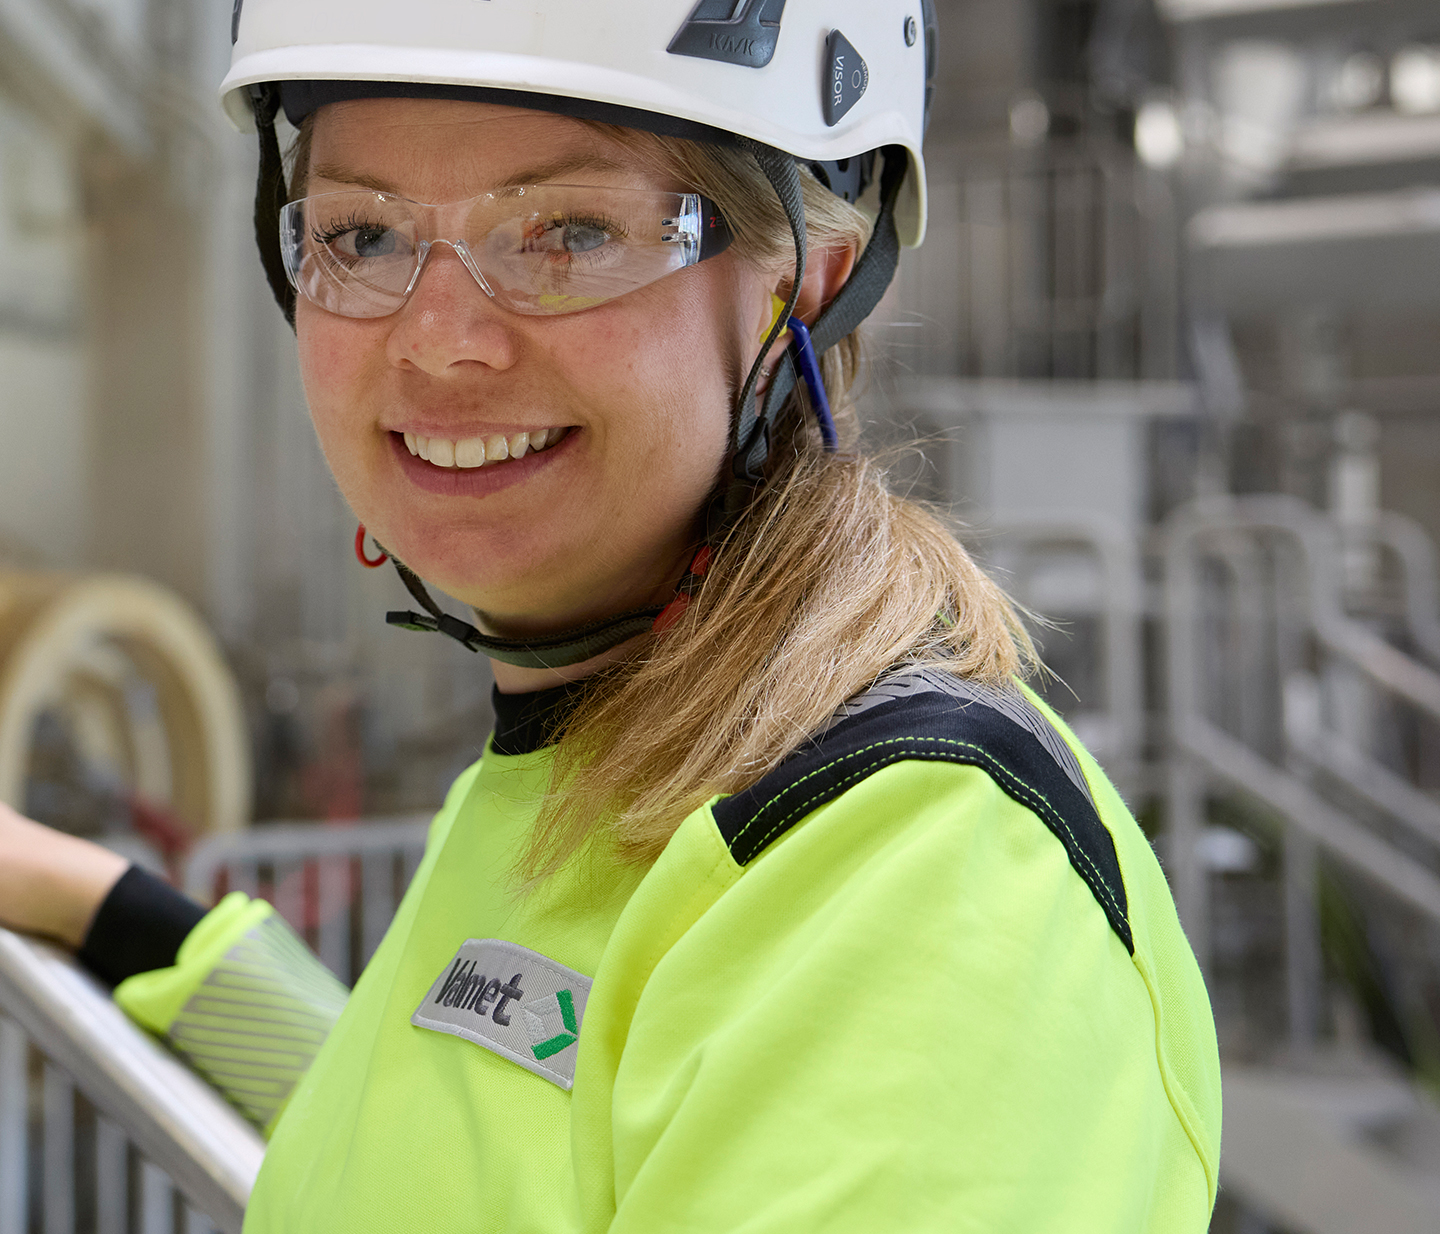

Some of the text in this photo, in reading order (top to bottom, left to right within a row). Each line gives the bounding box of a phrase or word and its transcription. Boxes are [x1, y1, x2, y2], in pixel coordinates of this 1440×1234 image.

[709, 32, 755, 56] KASK
[834, 55, 845, 106] VISOR
[434, 957, 524, 1027] Valmet
